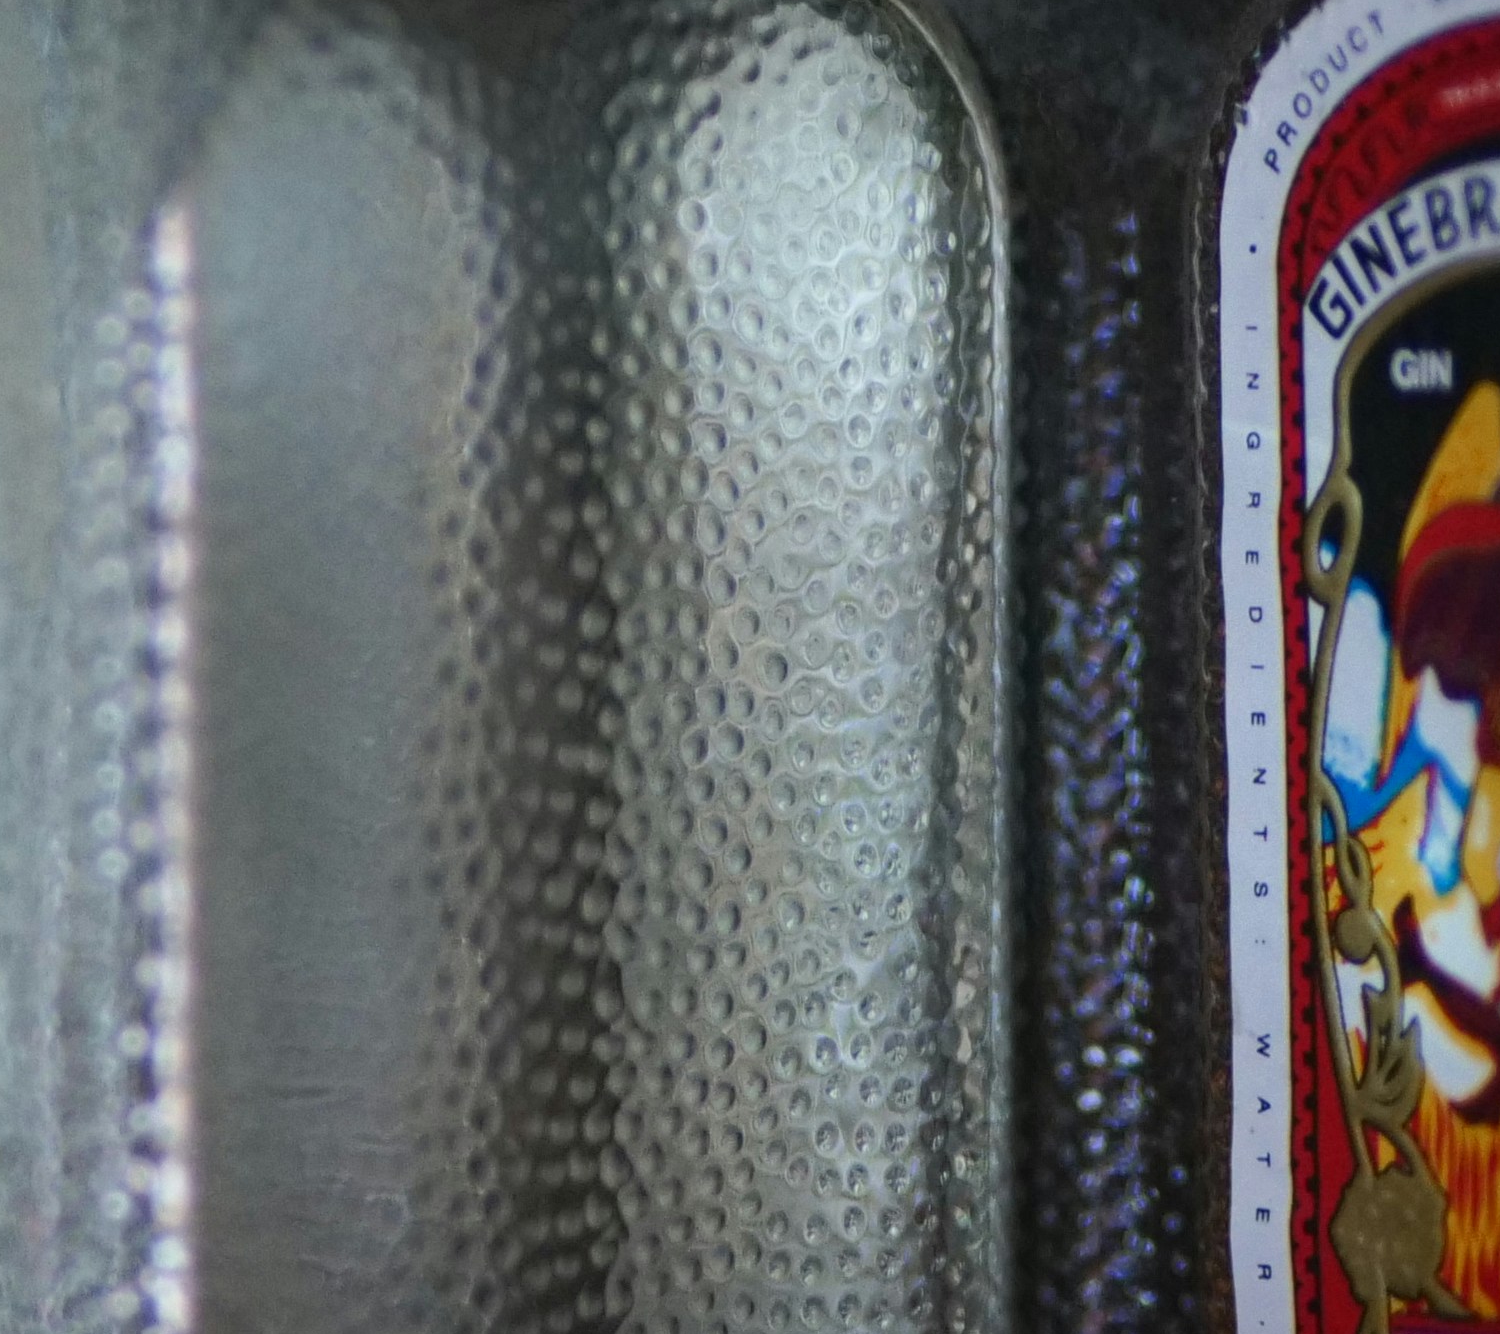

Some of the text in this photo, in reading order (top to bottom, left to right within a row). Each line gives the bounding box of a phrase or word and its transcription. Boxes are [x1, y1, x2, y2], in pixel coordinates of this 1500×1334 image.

[1264, 8, 1386, 175] PRODUCT
[1391, 348, 1453, 391] GIN
[1244, 322, 1270, 948] INGREDIENTS:
